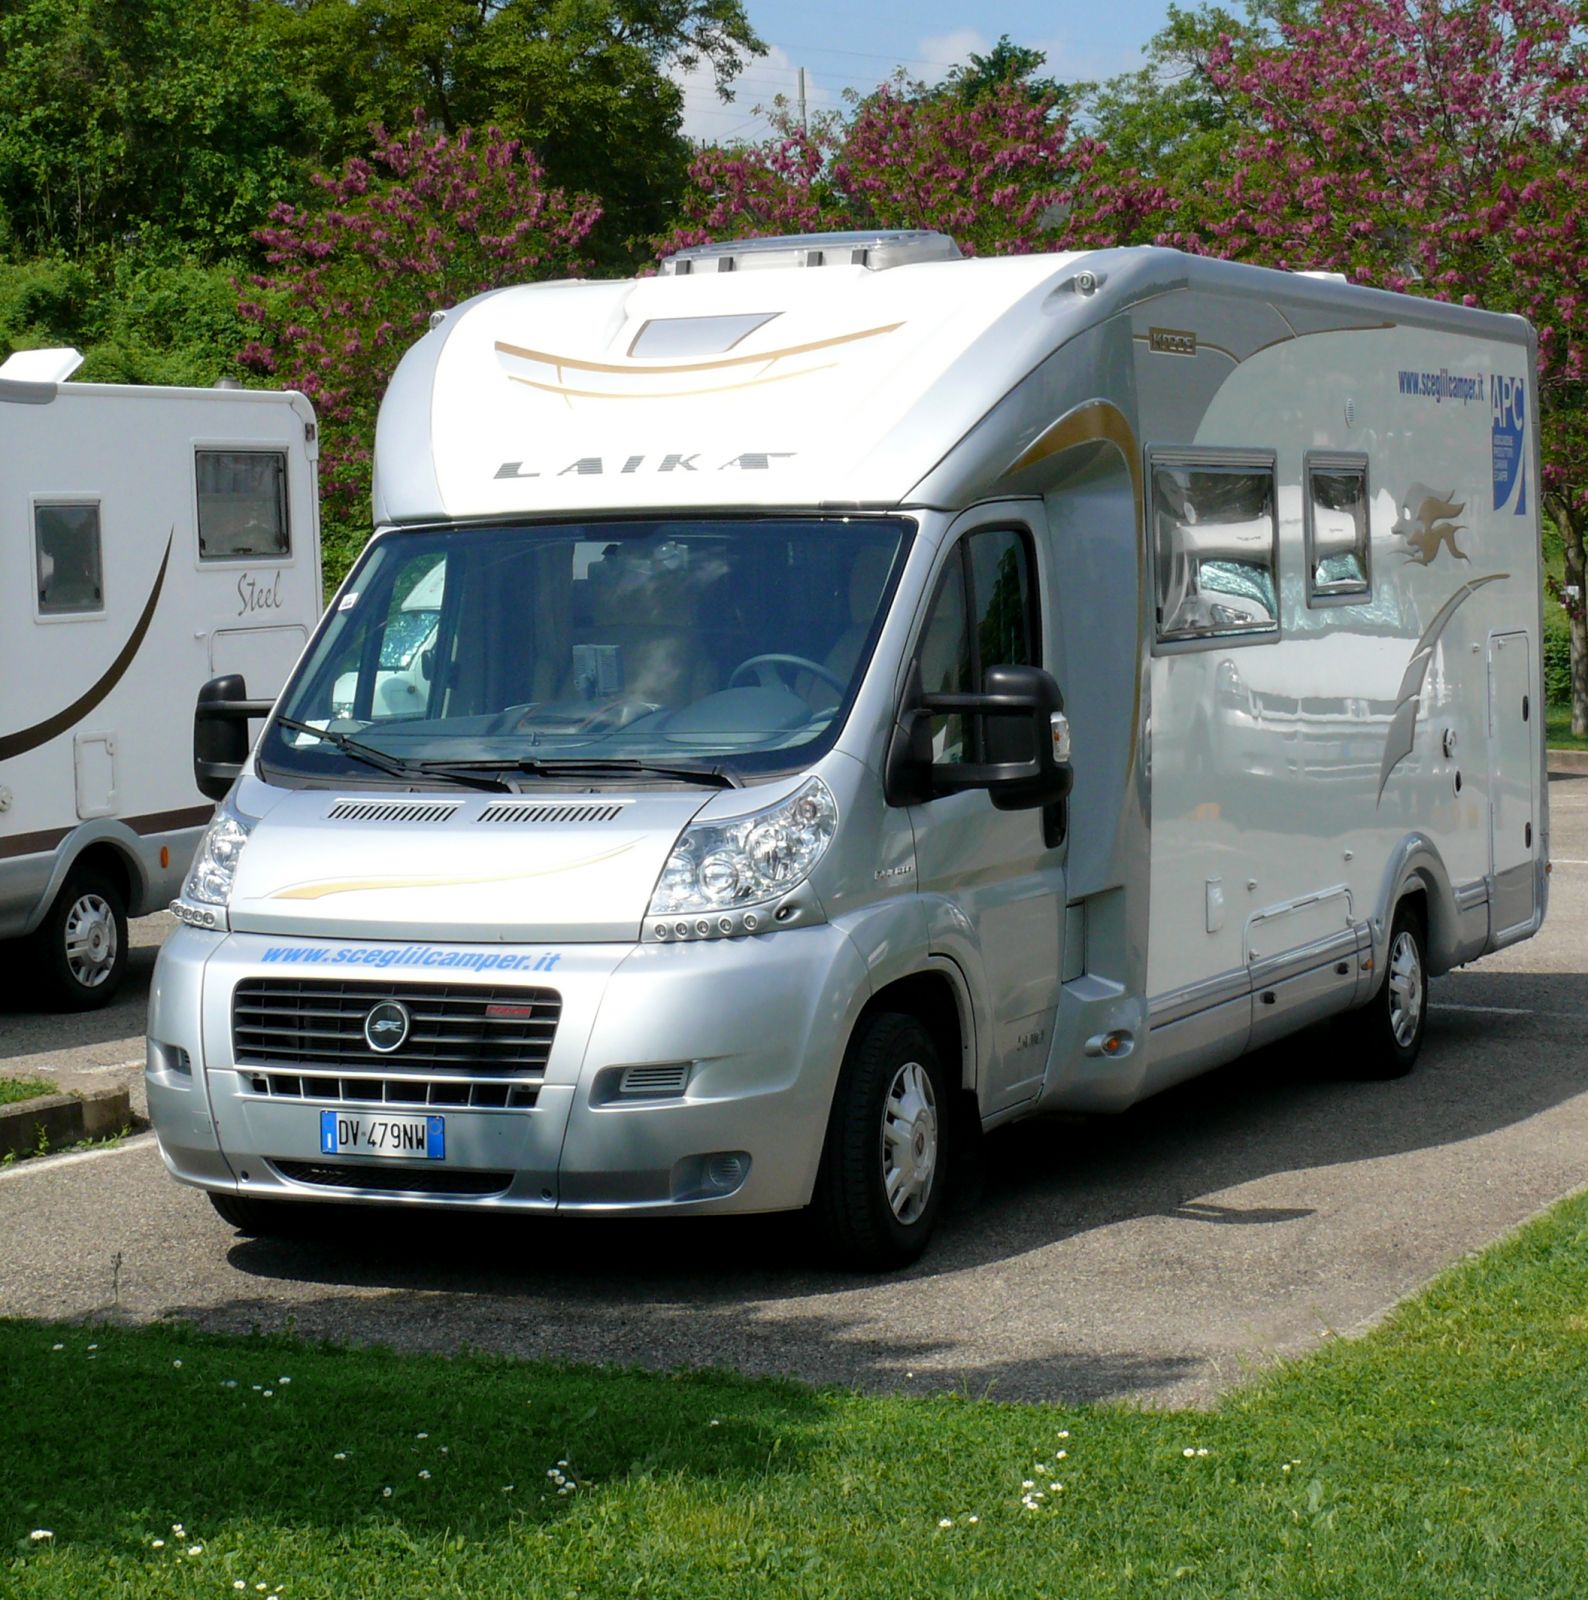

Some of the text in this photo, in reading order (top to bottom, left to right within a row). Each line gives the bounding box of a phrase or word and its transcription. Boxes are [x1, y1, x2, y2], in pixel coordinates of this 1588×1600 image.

[1490, 374, 1523, 431] APC
[493, 452, 798, 479] LAIKA
[237, 570, 284, 617] Steel
[261, 946, 561, 972] www.sceglilcamper.it
